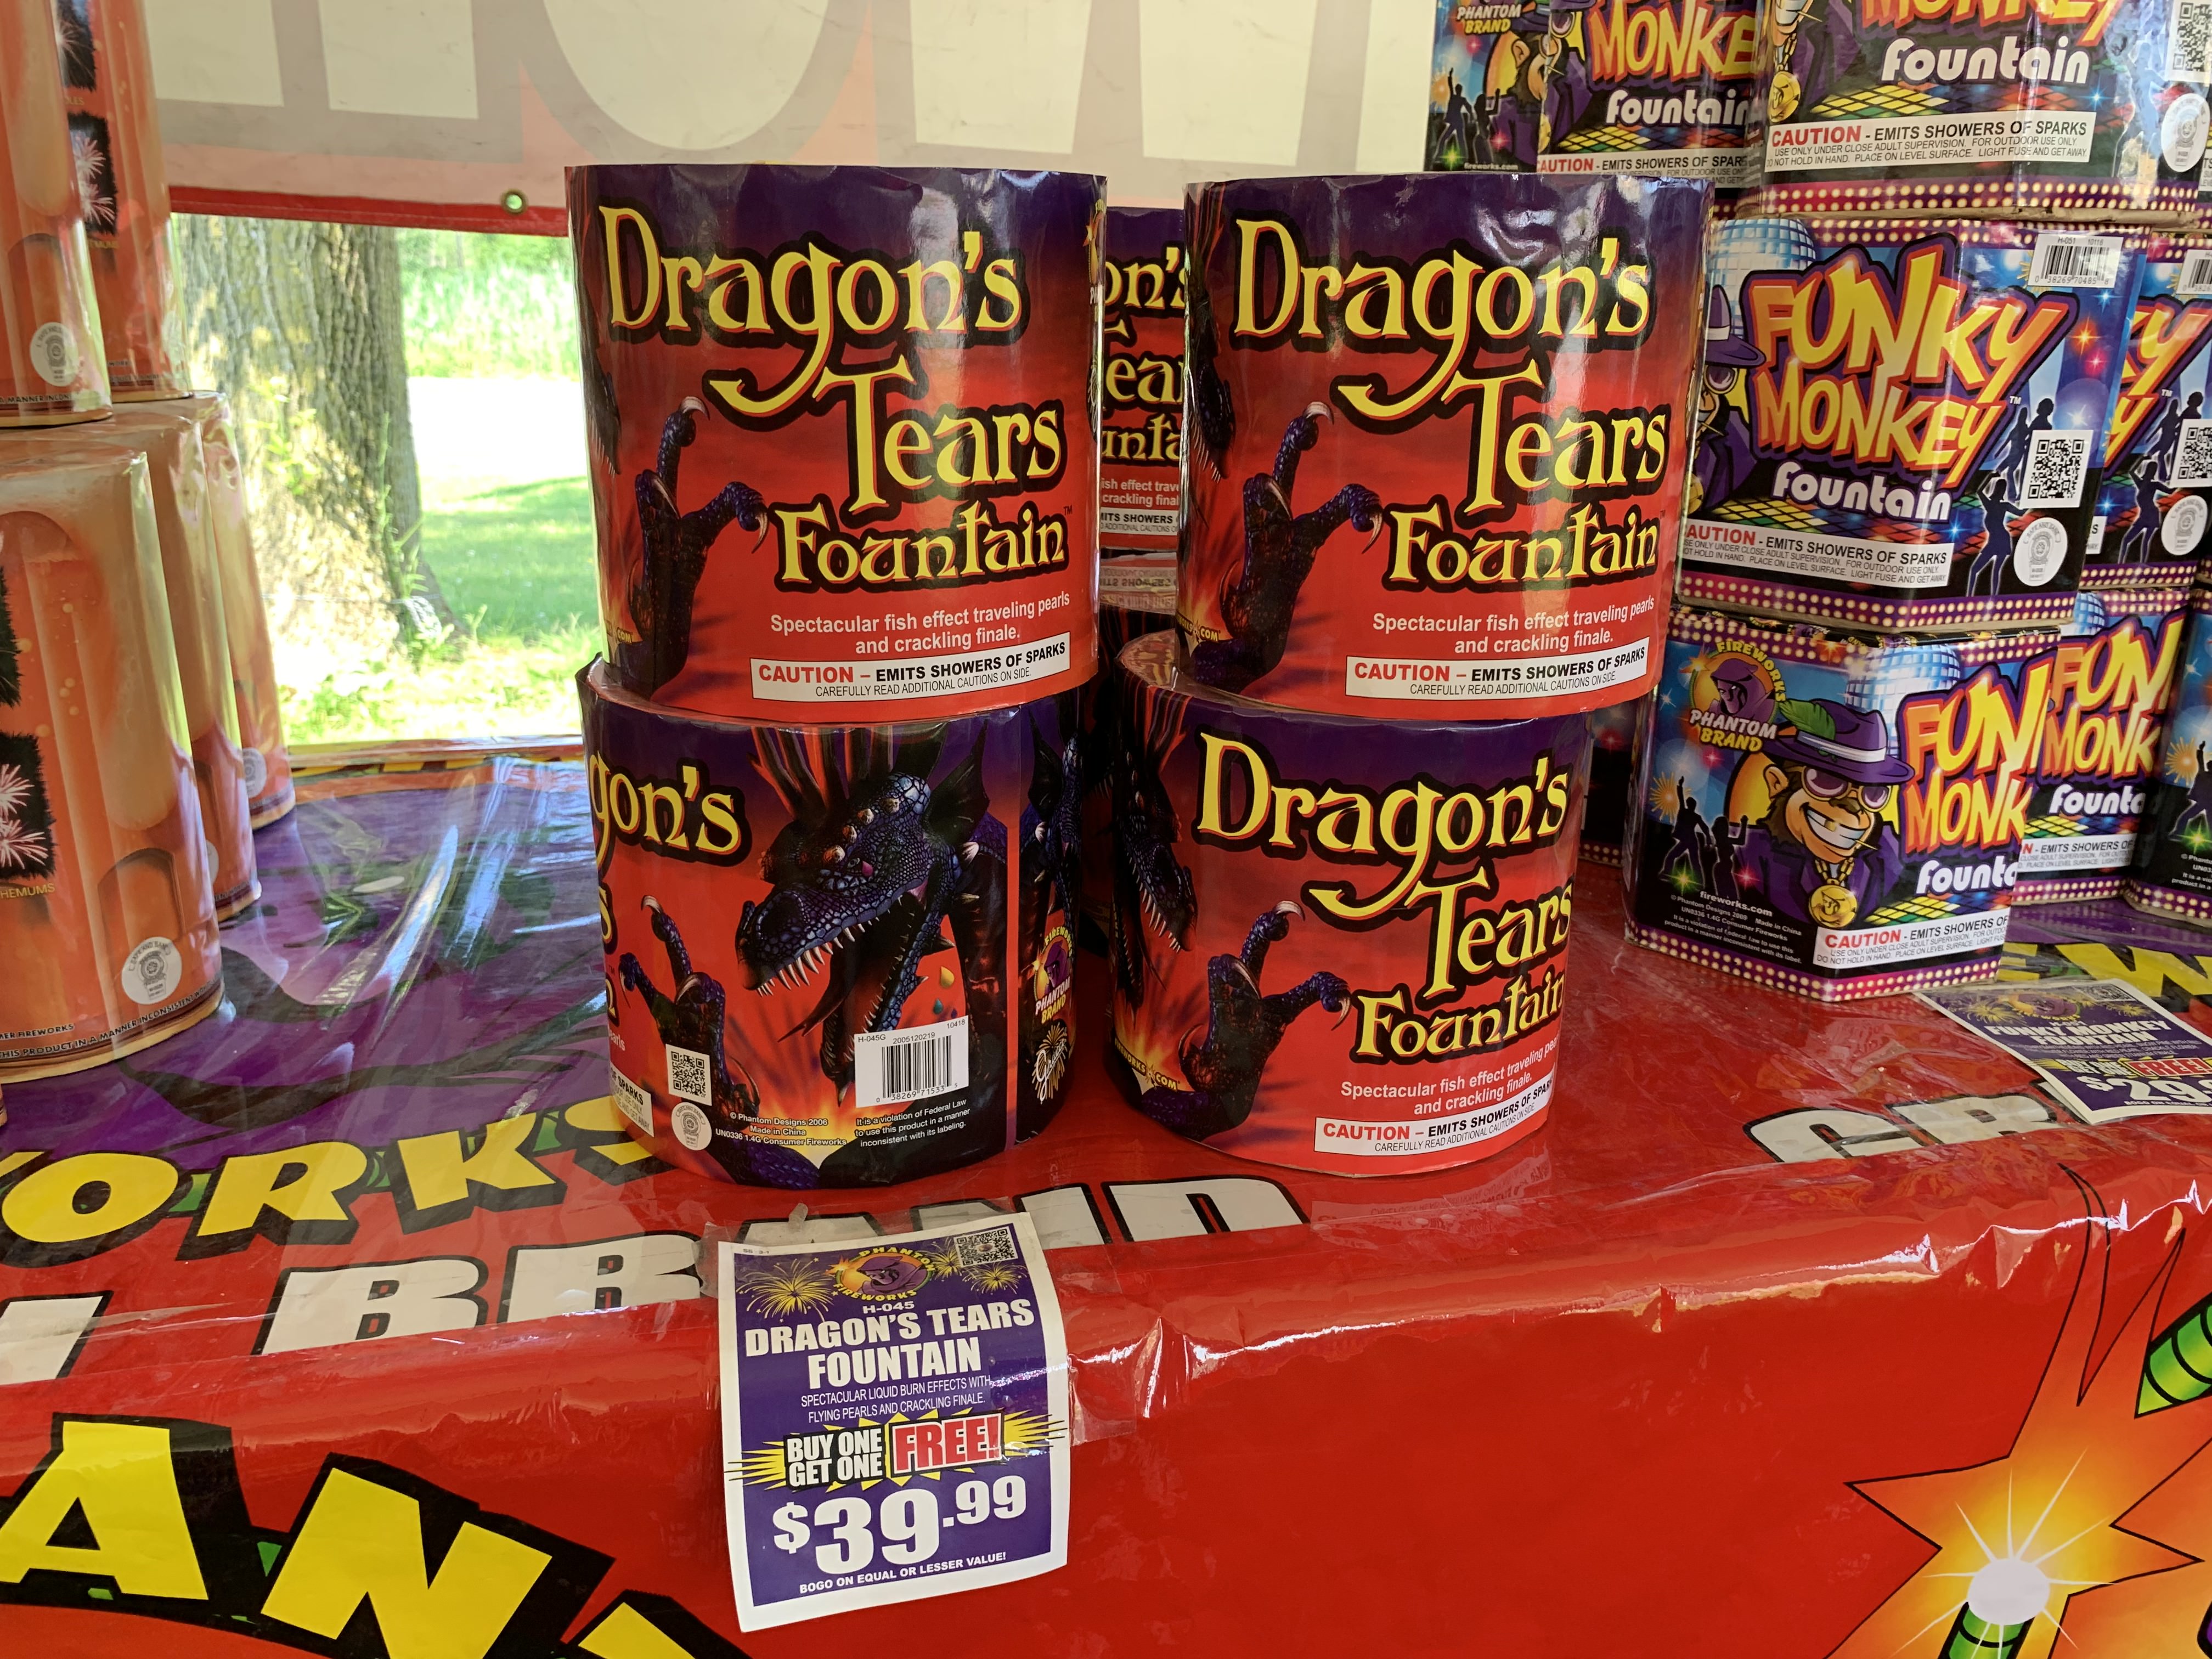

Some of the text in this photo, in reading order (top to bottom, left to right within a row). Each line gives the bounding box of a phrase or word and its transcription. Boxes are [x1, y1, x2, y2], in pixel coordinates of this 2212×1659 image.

[1457, 3, 1521, 20] PHANTOM
[1465, 18, 1512, 35] BRAND
[1881, 36, 2089, 84] fountain
[1771, 121, 2086, 146] CAUTION EMITS SHOWERS OF SPARKS
[1775, 147, 1789, 156] USE
[1791, 146, 1813, 155] ONLY
[1814, 144, 1844, 154] UNDER
[1845, 142, 1874, 152] CLOSE
[1875, 140, 1903, 151] ADULT
[1905, 138, 1966, 150] SUPERVISION.
[1972, 137, 1991, 146] FOR
[1993, 136, 2039, 146] OUTDOOR
[2040, 136, 2056, 145] USE
[599, 205, 1023, 417] Dragon's
[1234, 219, 1650, 417] Dragon's
[1749, 247, 2068, 405] FUNKY
[812, 354, 1060, 514] Tears
[1441, 359, 1667, 514] Tears
[1756, 356, 2005, 488] MONKEY
[1121, 481, 1152, 491] effect
[1773, 461, 1952, 521] fountain
[1123, 513, 1173, 524] SHOWERS
[774, 500, 1066, 584] Fountain
[1390, 501, 1658, 583] Fountain
[1766, 536, 1804, 552] EMITS
[1807, 541, 1873, 560] SHOWERS
[1877, 550, 1897, 562] OF
[1900, 552, 1947, 565] SPARKS
[770, 591, 1070, 636] Spectacular fish effect traveling pearls
[855, 627, 1020, 654] and crackling finale.
[758, 642, 1065, 684] CAUTION EMITS SHOWERS OF SPARKS
[1354, 646, 1645, 682] CAUTION EMITS SHOWERS OF SPARKS
[1717, 641, 1787, 702] FIREWORKS
[815, 685, 871, 697] CAREFULLY
[873, 684, 900, 696] READ
[902, 679, 956, 694] ADDITIONAL
[957, 673, 999, 690] CAUTIONS
[1000, 671, 1012, 682] ON
[1689, 709, 1778, 740] PHANTOM
[1701, 727, 1763, 752] BRAND
[1198, 732, 1568, 920] Dragon's
[1700, 890, 1773, 917] fireworks.com
[1404, 866, 1572, 1001] Tears
[1825, 929, 1902, 949] CAUTION
[1910, 927, 1941, 940] EMITS
[1944, 917, 1994, 937] SHOWERS
[1035, 975, 1071, 1016] PHANTOM
[1041, 994, 1067, 1024] BRAND
[22, 1041, 72, 1056] PRODUCT
[75, 1038, 87, 1047] IN
[89, 1036, 98, 1044] A
[100, 1019, 138, 1041] MANNER
[858, 1019, 966, 1044] H-045G 2005120219 10418
[2031, 1030, 2159, 1046] FOUNTAIN
[2072, 1020, 2172, 1036] MONKEY
[618, 1075, 644, 1105] SPARKS
[1341, 1048, 1543, 1101] Spectacular fish effect traveling
[891, 1085, 945, 1101] 38269 71533
[1414, 1071, 1532, 1115] and crackling finale.
[738, 1113, 772, 1124] Phantom
[774, 1118, 806, 1127] Designs
[855, 1129, 864, 1137] to
[882, 1125, 896, 1134] this
[899, 1120, 928, 1132] product
[944, 1108, 970, 1122] manner
[880, 1111, 913, 1124] violation
[915, 1109, 923, 1118] of
[924, 1102, 951, 1116] Federal
[952, 1098, 967, 1108] Law
[715, 1128, 743, 1140] UN0336
[745, 1134, 762, 1143] 1.4G
[763, 1136, 805, 1146] Consumer
[749, 1125, 771, 1135] Made
[860, 1120, 966, 1147] inconsistent with its labeling.
[833, 1282, 918, 1302] FIREWORKS
[862, 1301, 915, 1314] H-045
[745, 1299, 1036, 1358] DRAGON'S TEARS
[807, 1337, 982, 1390] FOUNTAIN
[801, 1375, 991, 1408] SPECTACULAR LIQUID BURN EFFECTS WITH
[808, 1392, 986, 1424] FLYING PEARLS AND CRACKLING FINALE.
[787, 1428, 883, 1464] BUY ONE
[891, 1412, 1003, 1475] FREE!
[788, 1454, 884, 1488] GET ONE
[772, 1475, 1026, 1576] $39.99
[799, 1551, 1007, 1594] BOGO ON EQUAL OR LESSER VALUE!
